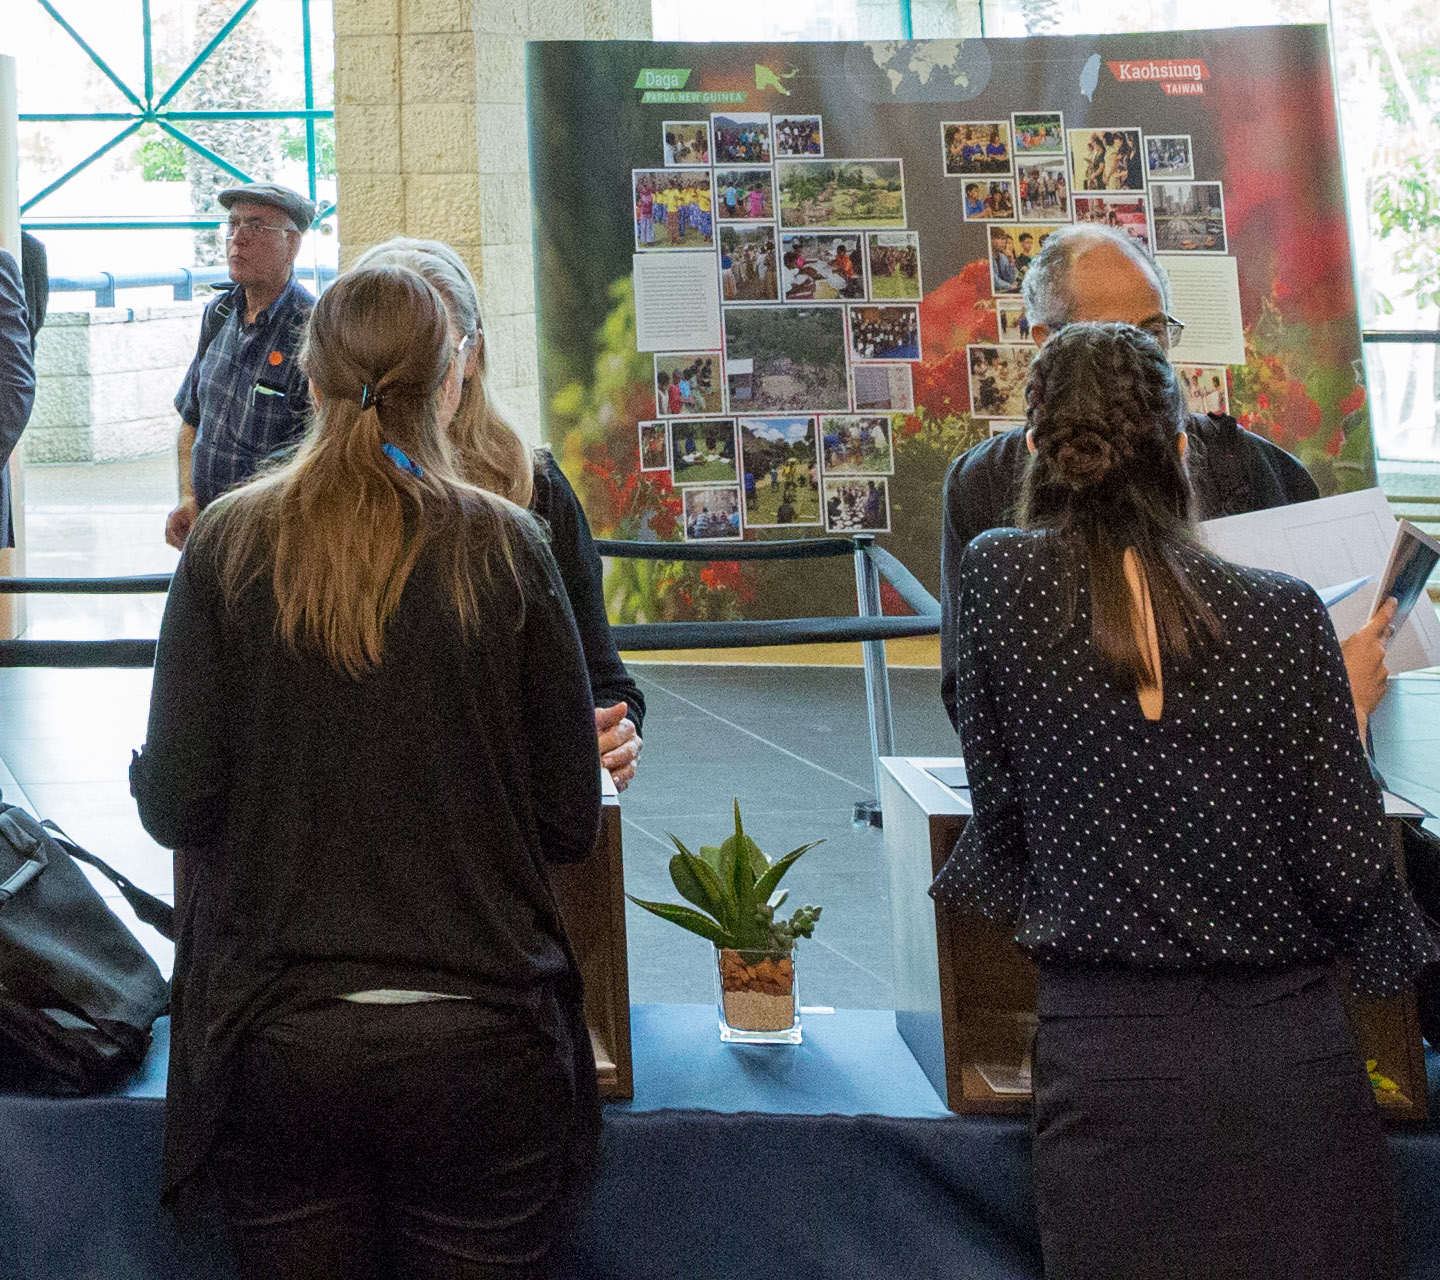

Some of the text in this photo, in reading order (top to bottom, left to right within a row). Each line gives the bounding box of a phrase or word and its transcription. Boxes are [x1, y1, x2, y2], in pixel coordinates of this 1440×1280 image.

[1119, 62, 1201, 80] Kaohsiung
[644, 71, 680, 90] Daga
[1165, 83, 1203, 94] TAIWAN
[646, 92, 743, 103] PAPUA NEW GUINEA
